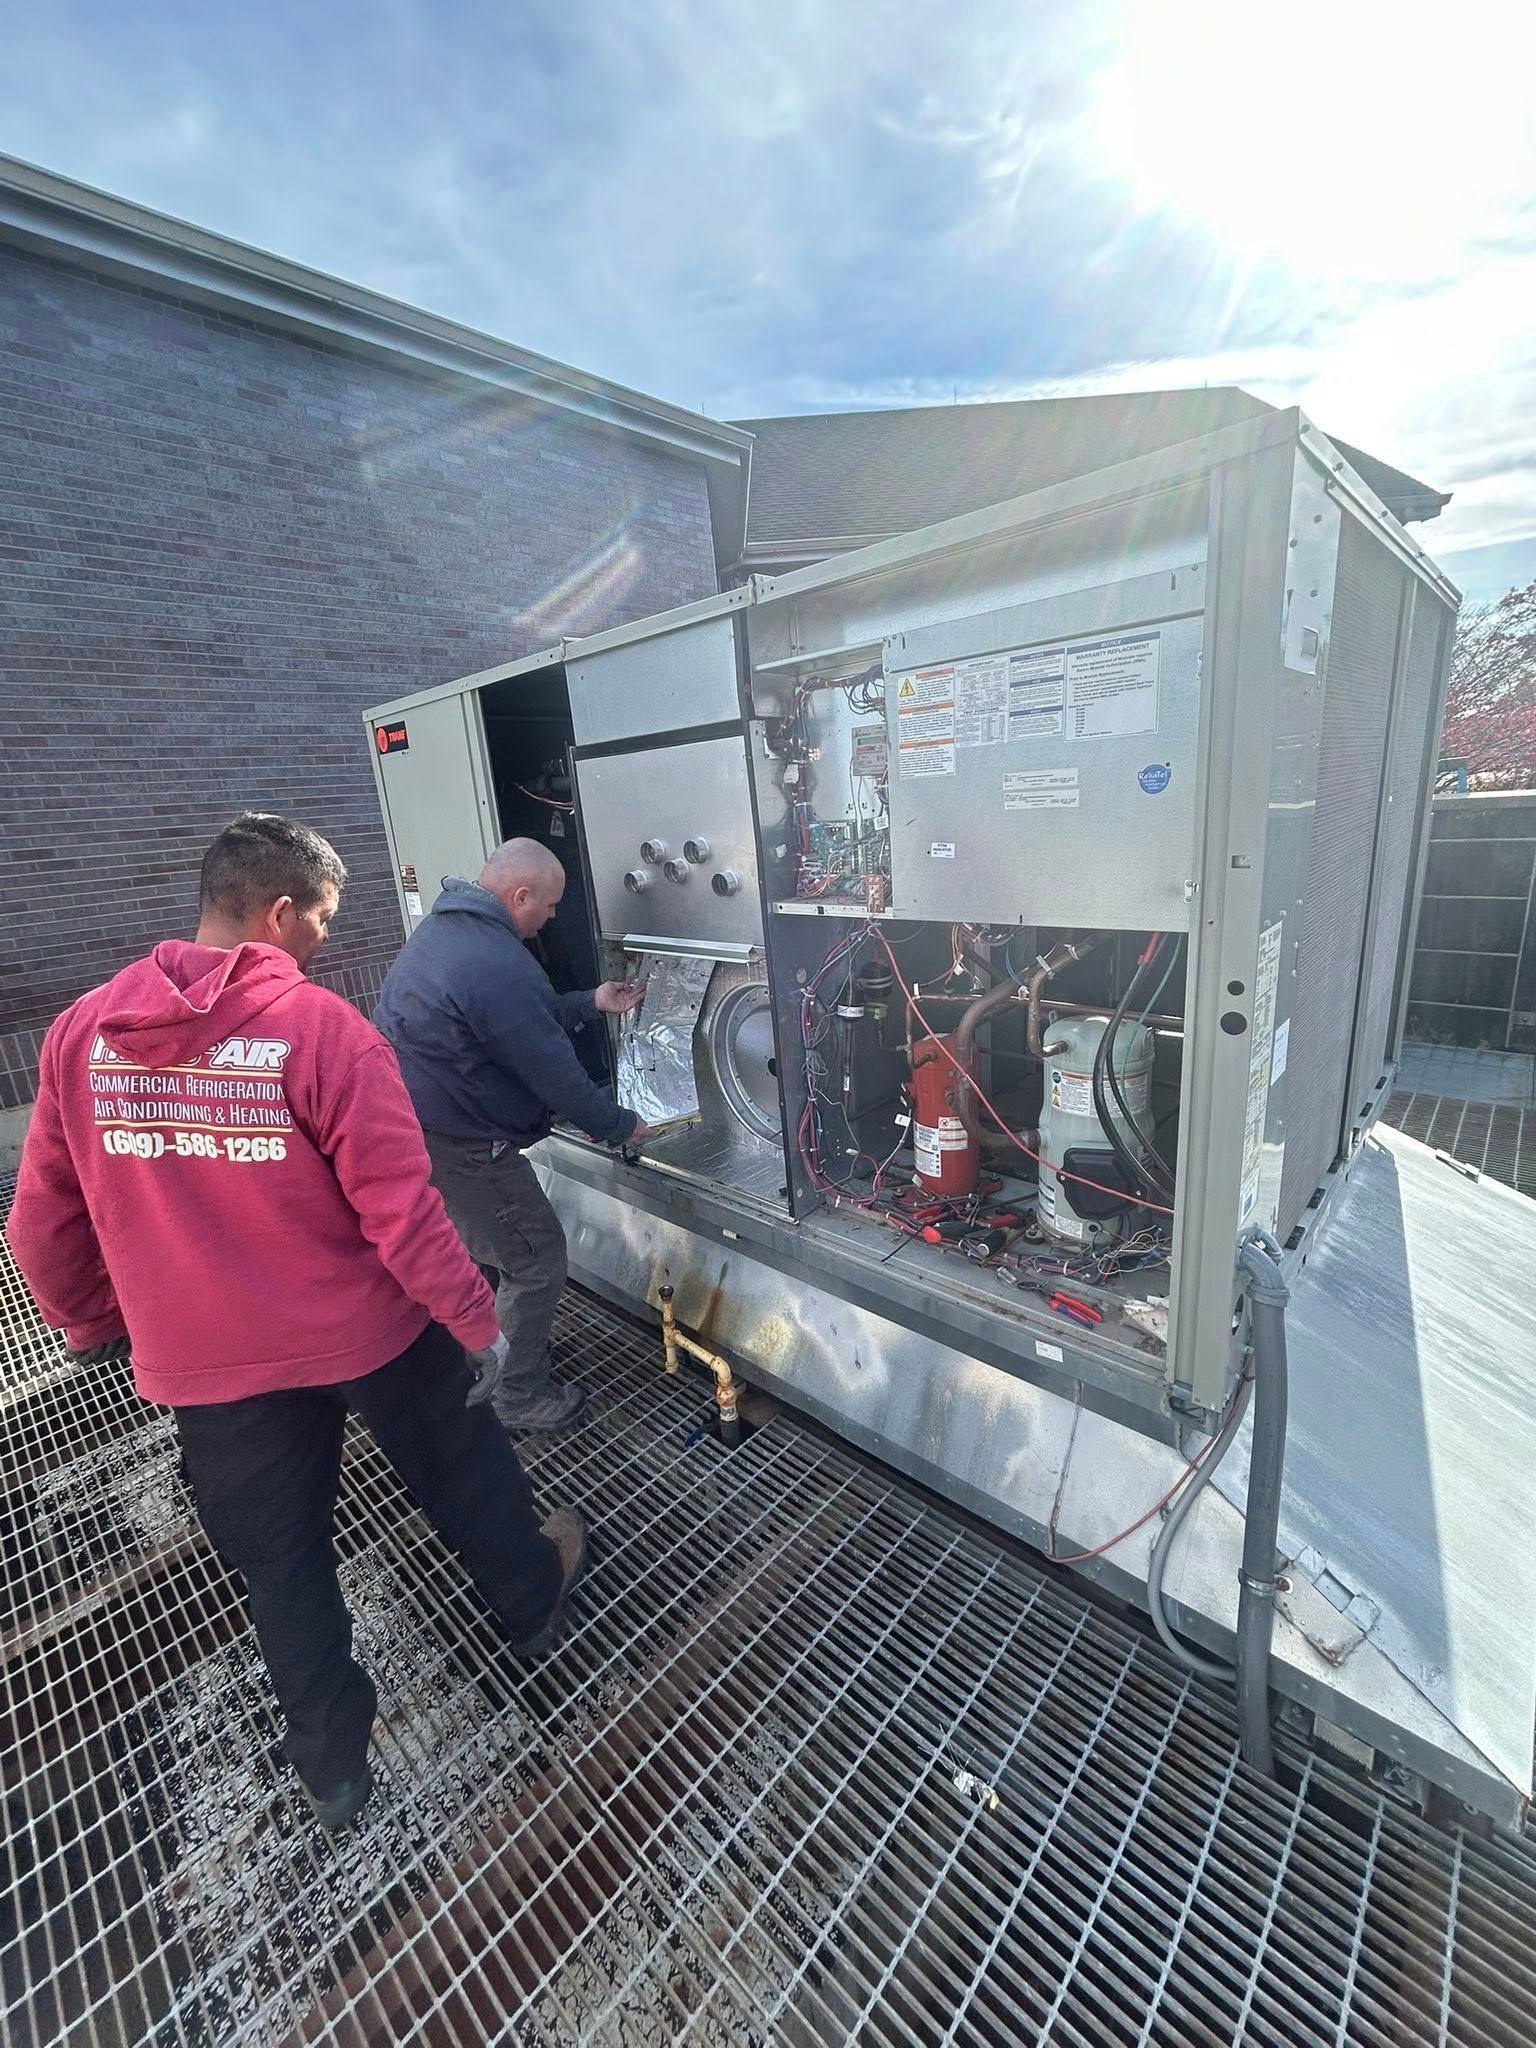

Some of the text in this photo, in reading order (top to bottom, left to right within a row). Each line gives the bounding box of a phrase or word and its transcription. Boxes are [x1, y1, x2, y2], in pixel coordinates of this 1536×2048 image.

[89, 1071, 286, 1101] COMMERCIAL REFRIGERATION
[94, 1097, 291, 1126] AIR CONDITIONING & HEATING
